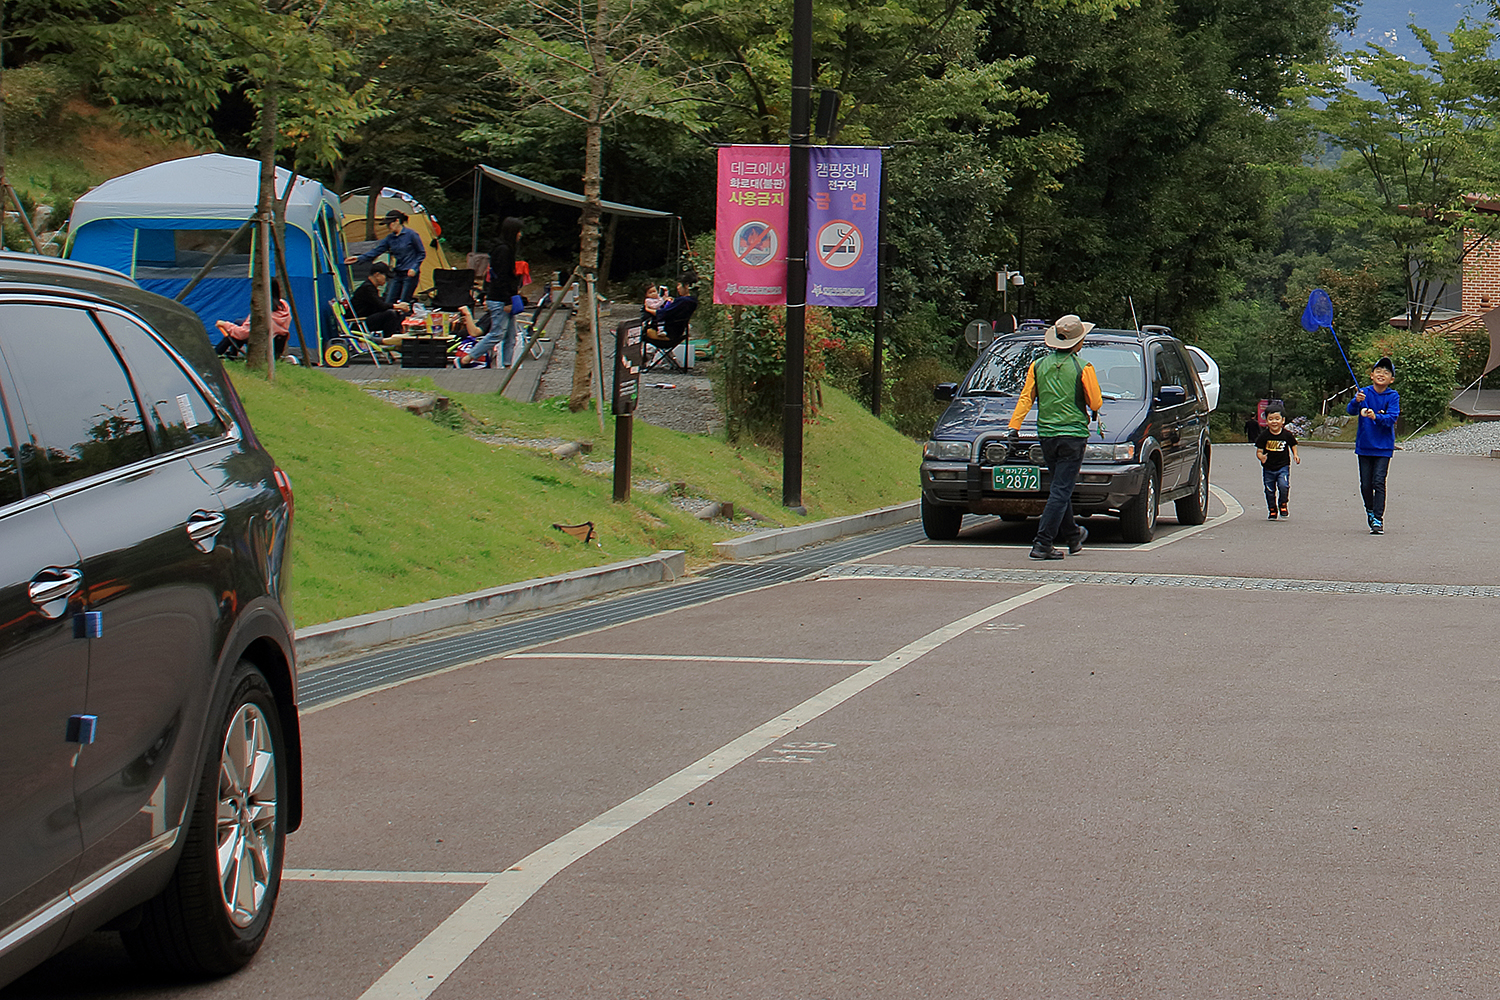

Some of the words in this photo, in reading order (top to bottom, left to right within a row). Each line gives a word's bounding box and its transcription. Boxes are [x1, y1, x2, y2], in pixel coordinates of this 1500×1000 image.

[730, 161, 786, 176] 데크에서
[815, 163, 870, 179] 캠핑장내
[827, 180, 858, 191] 전구역
[728, 191, 785, 207] 사용금지
[815, 192, 832, 211] 금
[850, 192, 867, 211] 연
